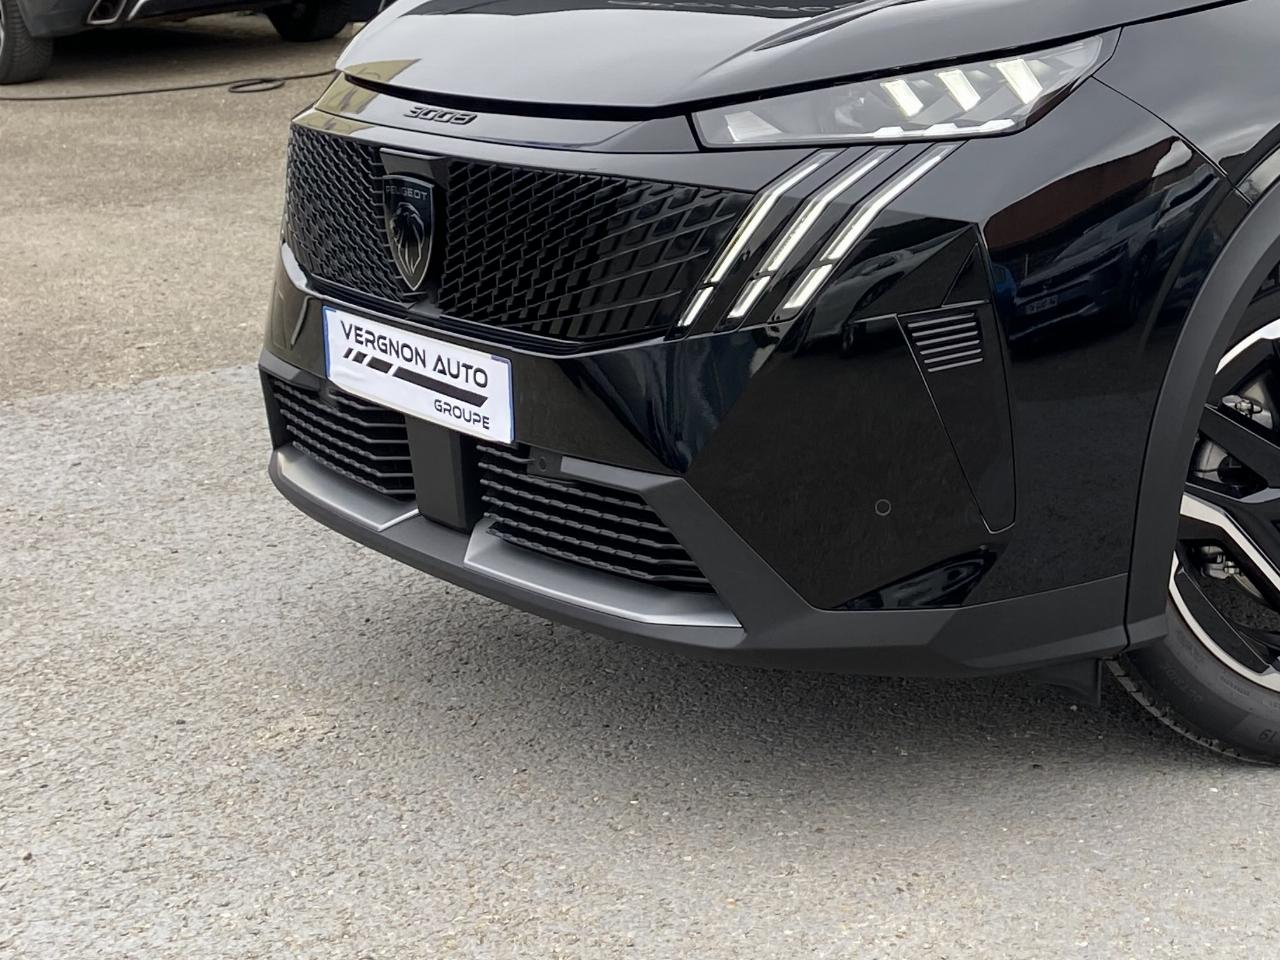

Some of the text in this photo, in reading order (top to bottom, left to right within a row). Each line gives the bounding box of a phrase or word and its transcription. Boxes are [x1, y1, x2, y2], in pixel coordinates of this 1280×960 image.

[403, 106, 478, 125] 3008
[386, 185, 428, 200] PEUGEOT
[340, 320, 488, 388] VERGNON AUTO
[434, 398, 490, 430] GROUPE
